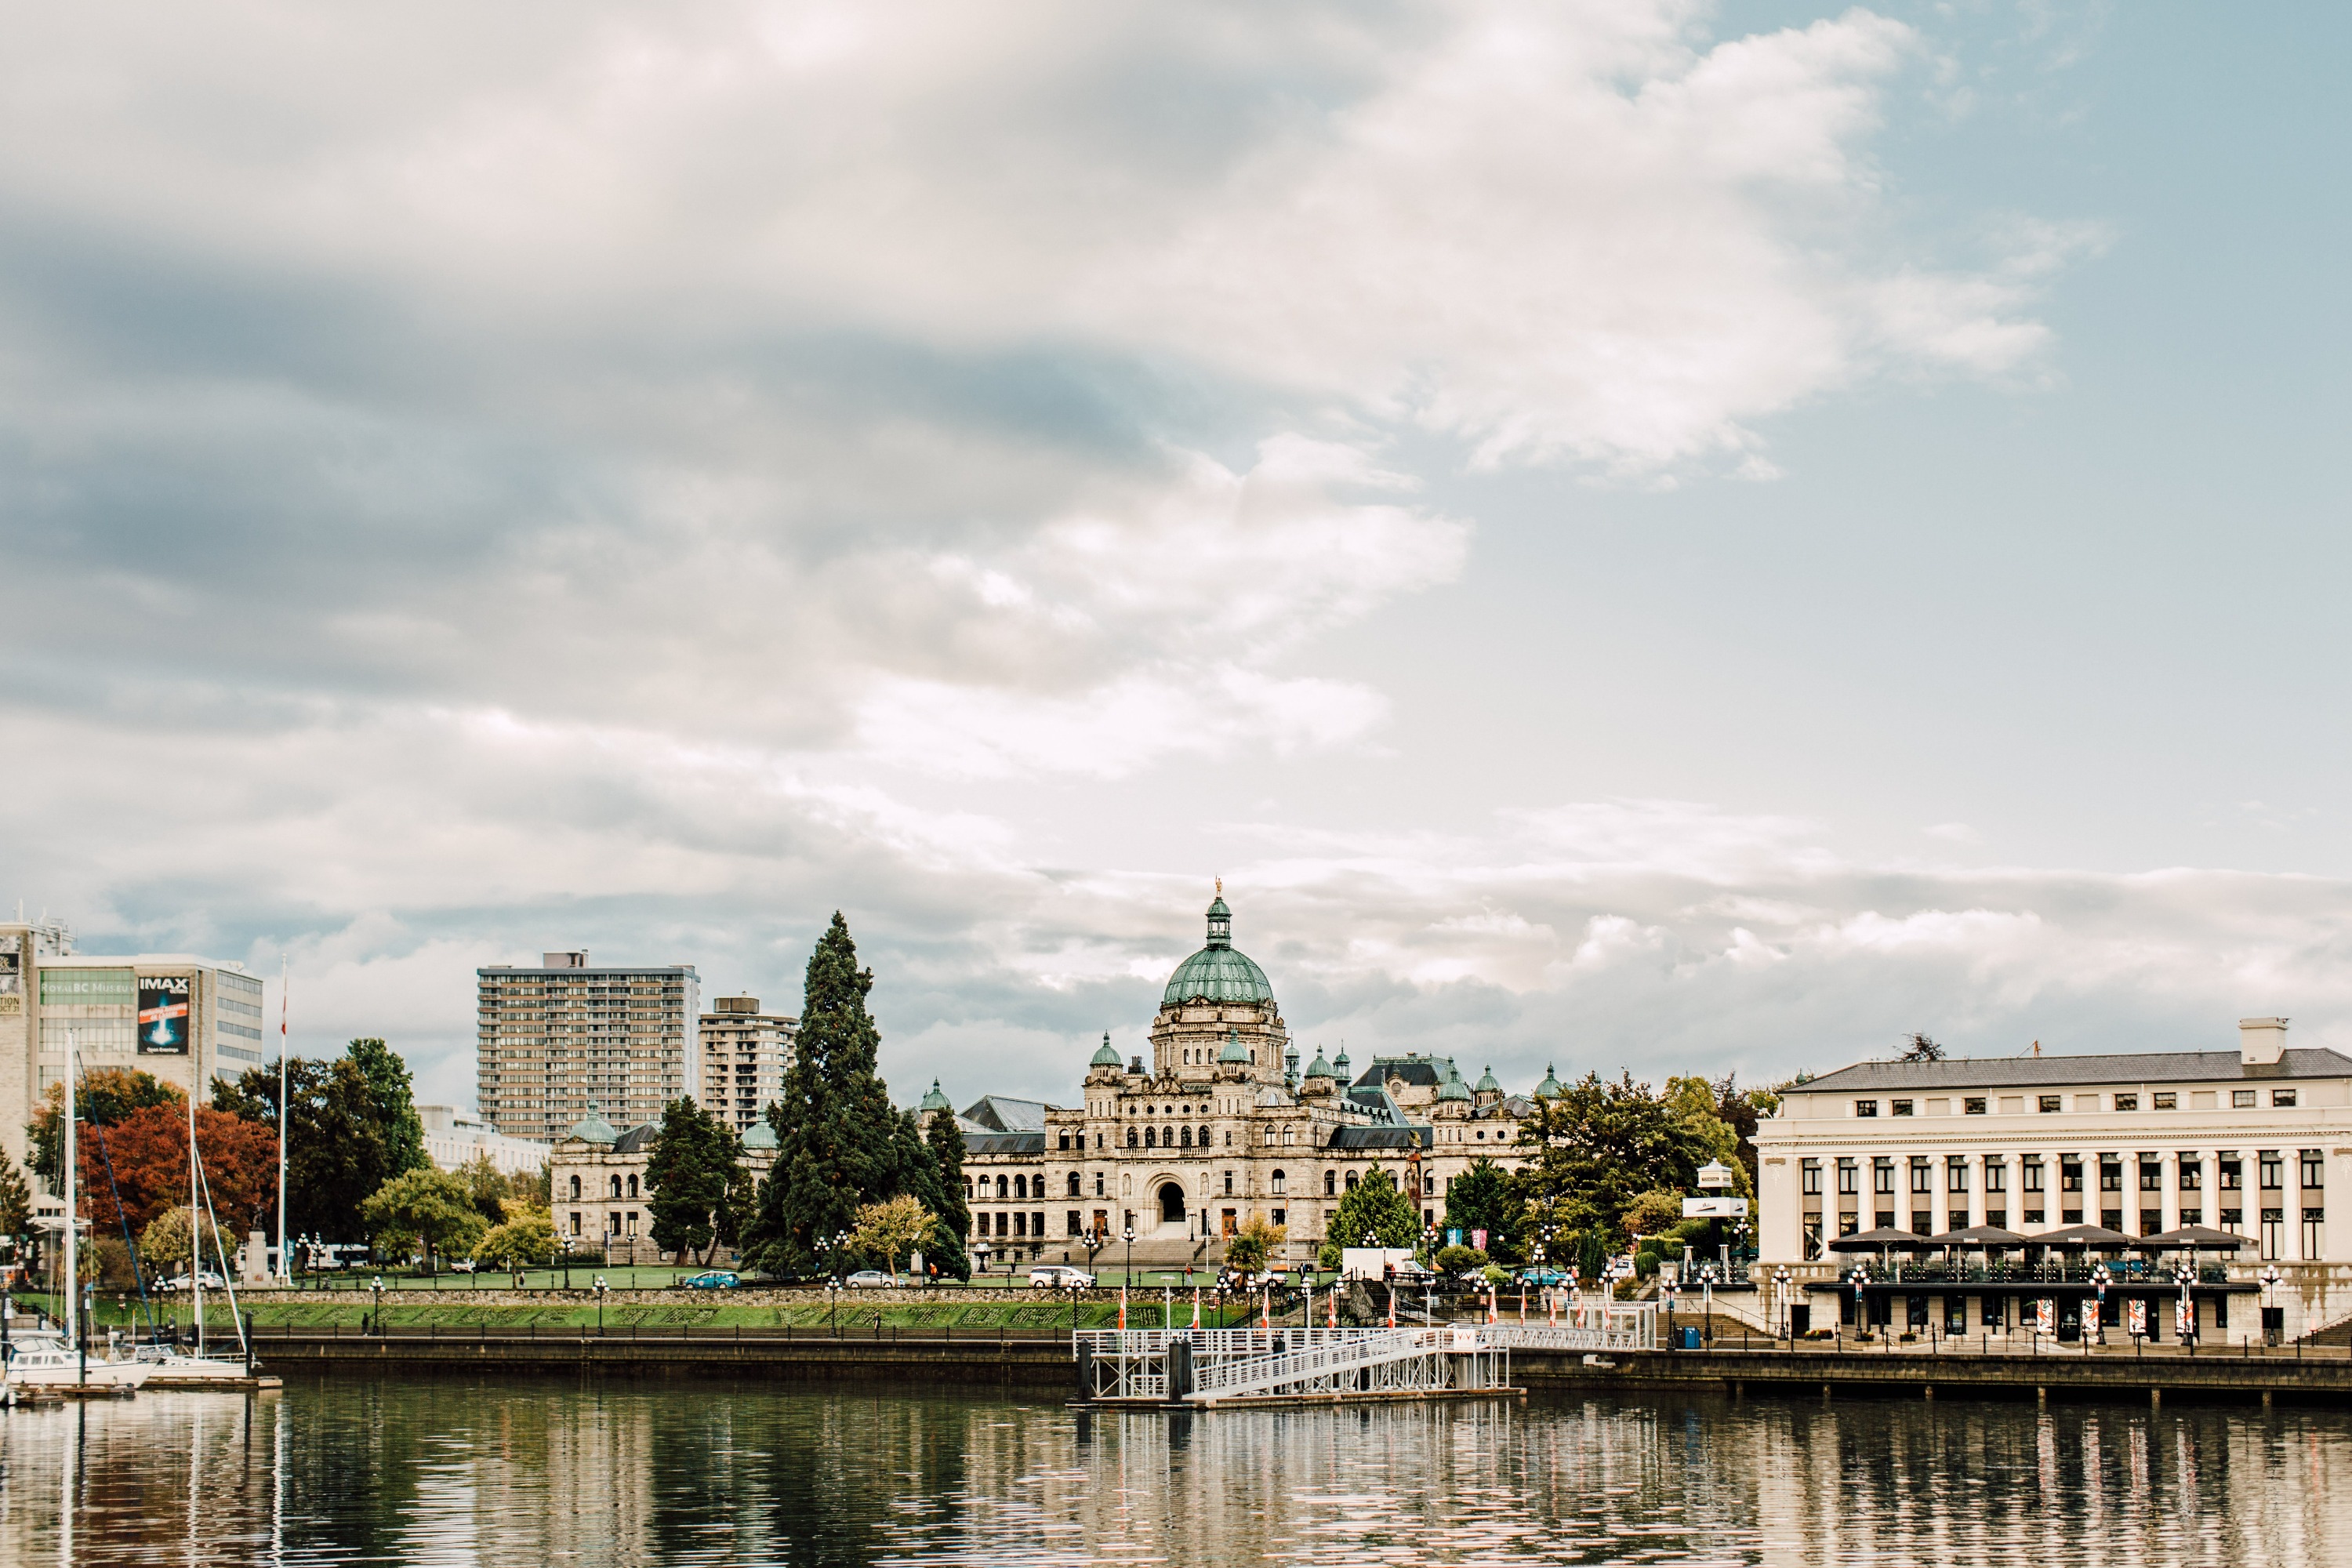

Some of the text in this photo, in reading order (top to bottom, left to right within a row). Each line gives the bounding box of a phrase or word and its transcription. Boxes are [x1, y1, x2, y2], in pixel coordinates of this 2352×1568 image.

[73, 983, 89, 993] BC
[140, 978, 188, 990] IMAX
[618, 1308, 720, 1325] TO
[776, 1307, 1158, 1326] VICTORIA
